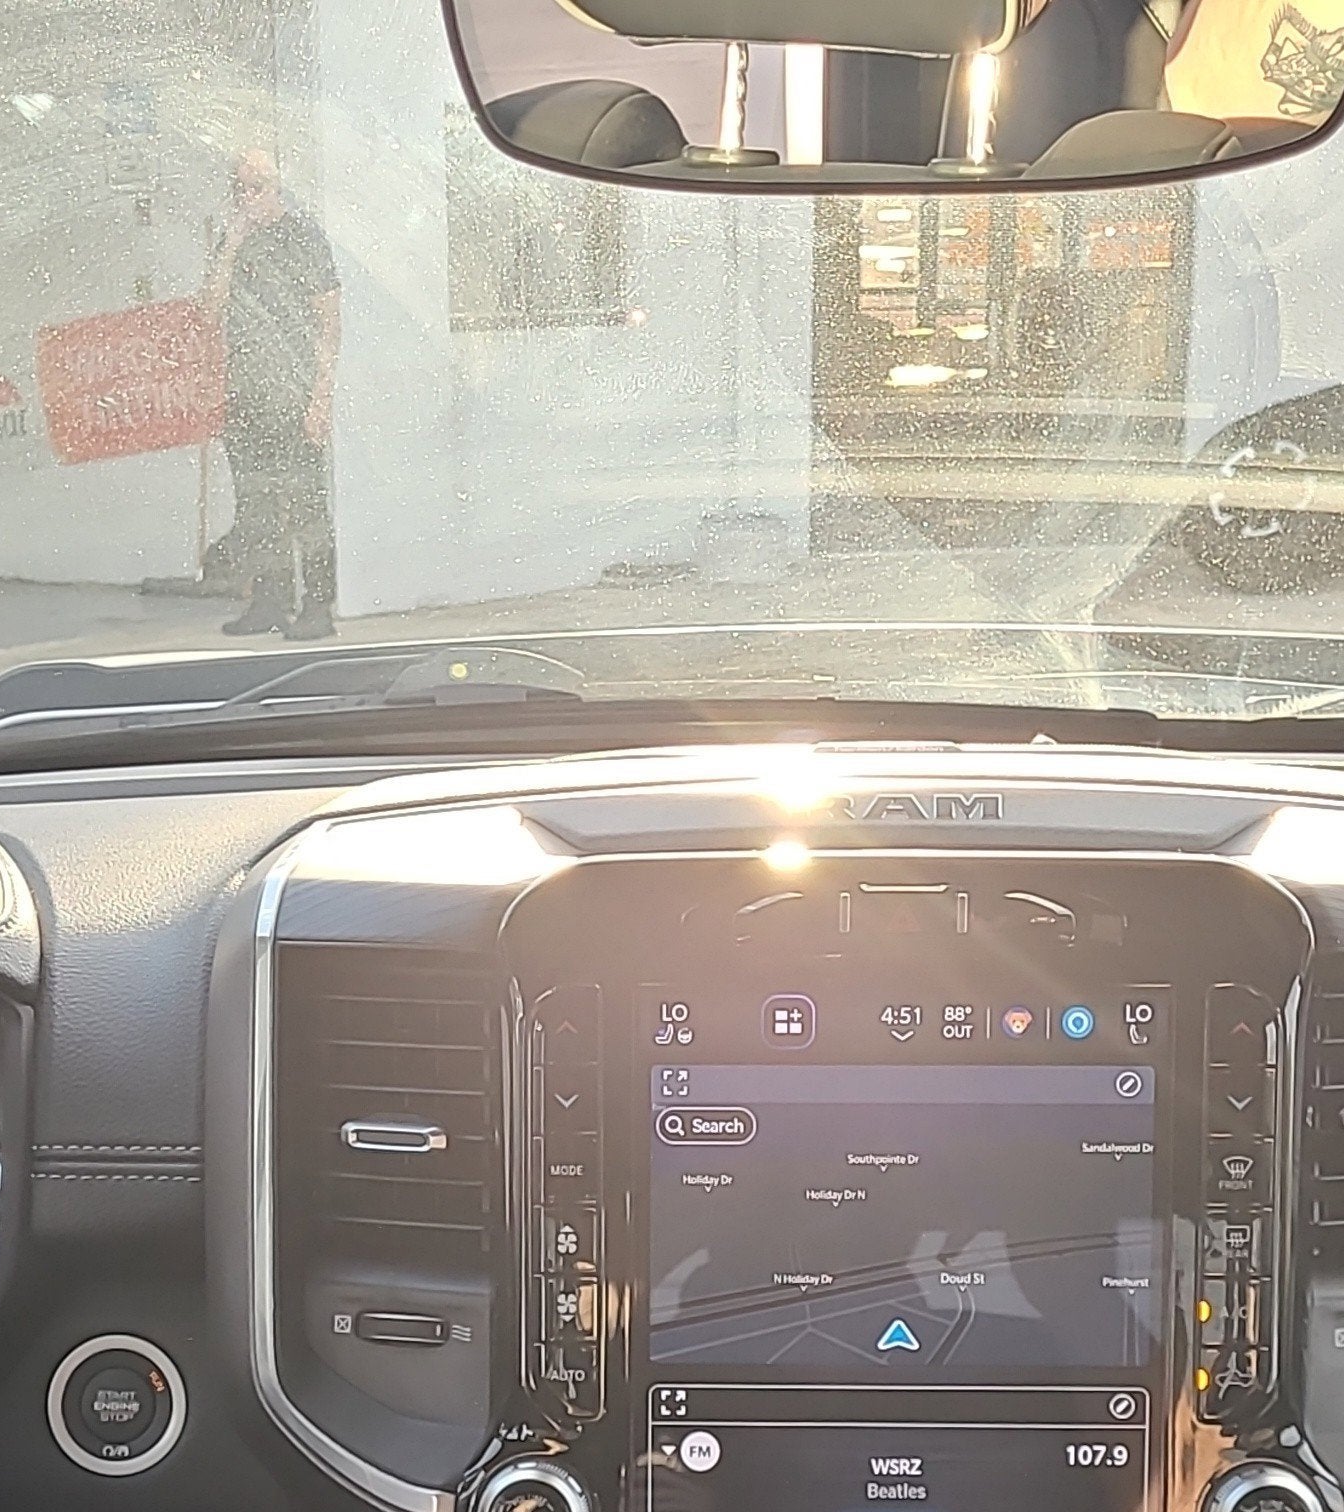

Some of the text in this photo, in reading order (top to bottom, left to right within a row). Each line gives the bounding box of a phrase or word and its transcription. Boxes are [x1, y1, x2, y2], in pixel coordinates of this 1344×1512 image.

[661, 1003, 689, 1022] LO
[880, 1006, 923, 1025] 4:51
[1125, 1003, 1153, 1023] LO
[943, 1024, 974, 1039] OUT
[691, 1117, 745, 1134] Search
[1142, 1142, 1154, 1153] Dr
[847, 1154, 920, 1166] Southpointe Dr
[549, 1164, 584, 1177] MODE
[682, 1175, 733, 1187] Holiday Dr
[806, 1189, 866, 1202] Holiday Dr N
[940, 1272, 986, 1285] Doud St
[1102, 1277, 1149, 1288] Pinehurst
[689, 1445, 712, 1458] FM
[1065, 1444, 1129, 1468] 107.9
[870, 1458, 924, 1477] WSRZ
[866, 1482, 927, 1500] Beatles
